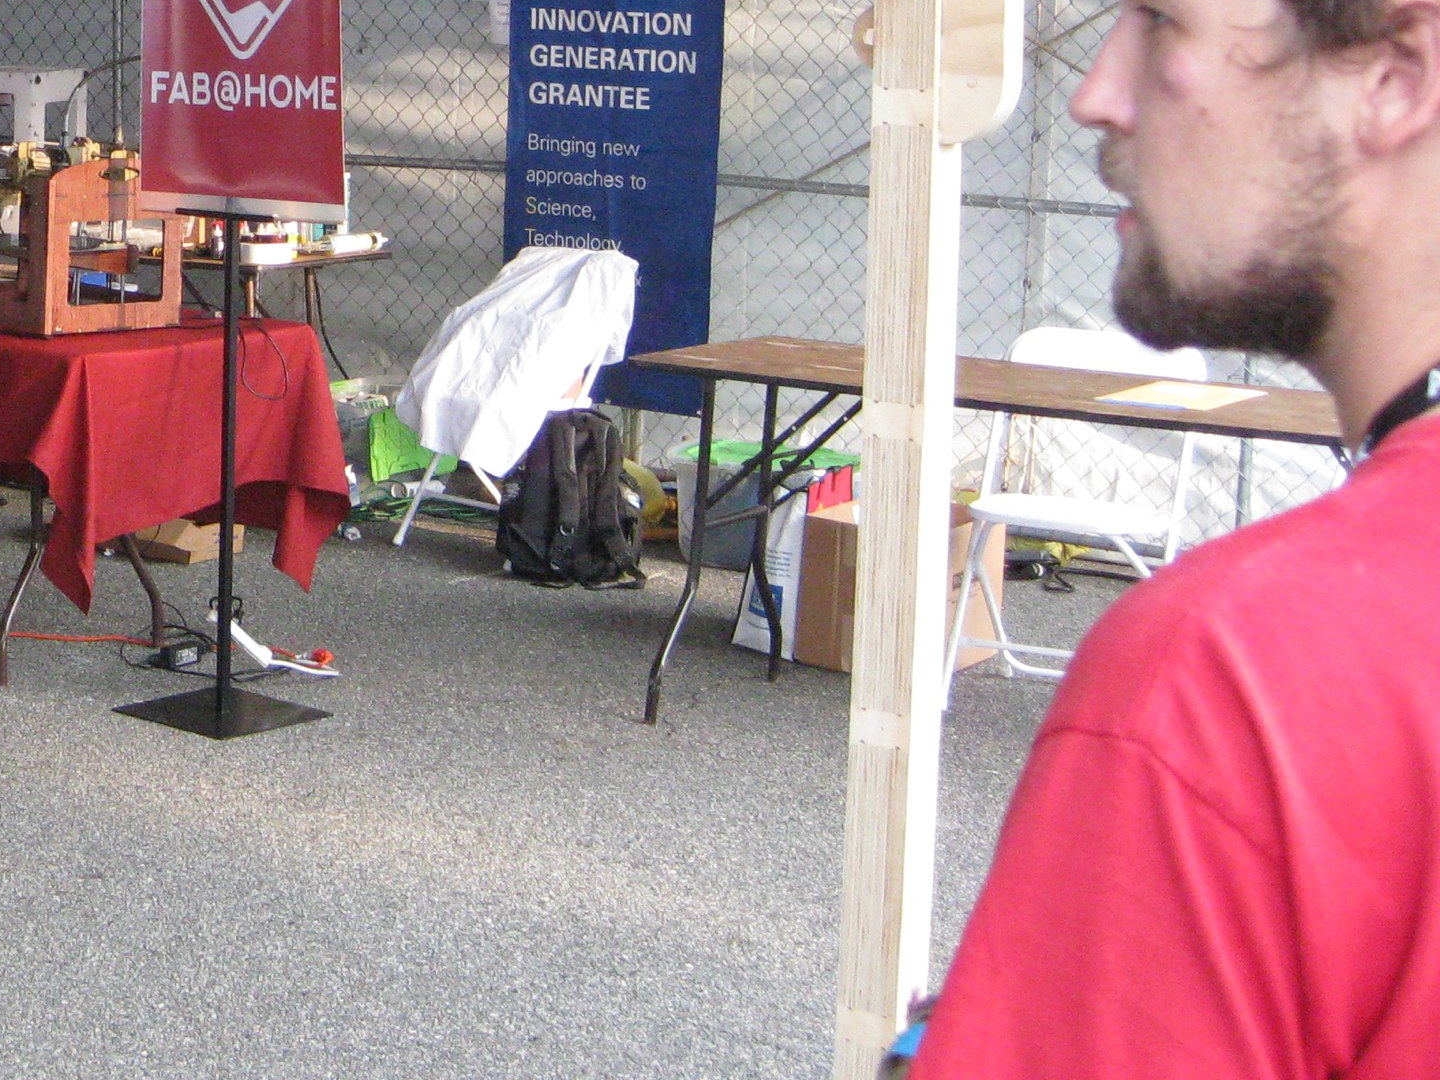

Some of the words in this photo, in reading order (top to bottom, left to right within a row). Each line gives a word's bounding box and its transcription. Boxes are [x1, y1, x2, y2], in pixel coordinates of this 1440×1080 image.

[530, 7, 692, 36] INNOVATION
[529, 44, 697, 74] GENERATION
[150, 70, 338, 111] FAB@HOME
[528, 81, 651, 110] GRANTEE
[527, 133, 597, 158] Bringing
[602, 142, 641, 157] new
[526, 169, 624, 189] approaches
[630, 174, 647, 190] to
[525, 196, 597, 221] Science,
